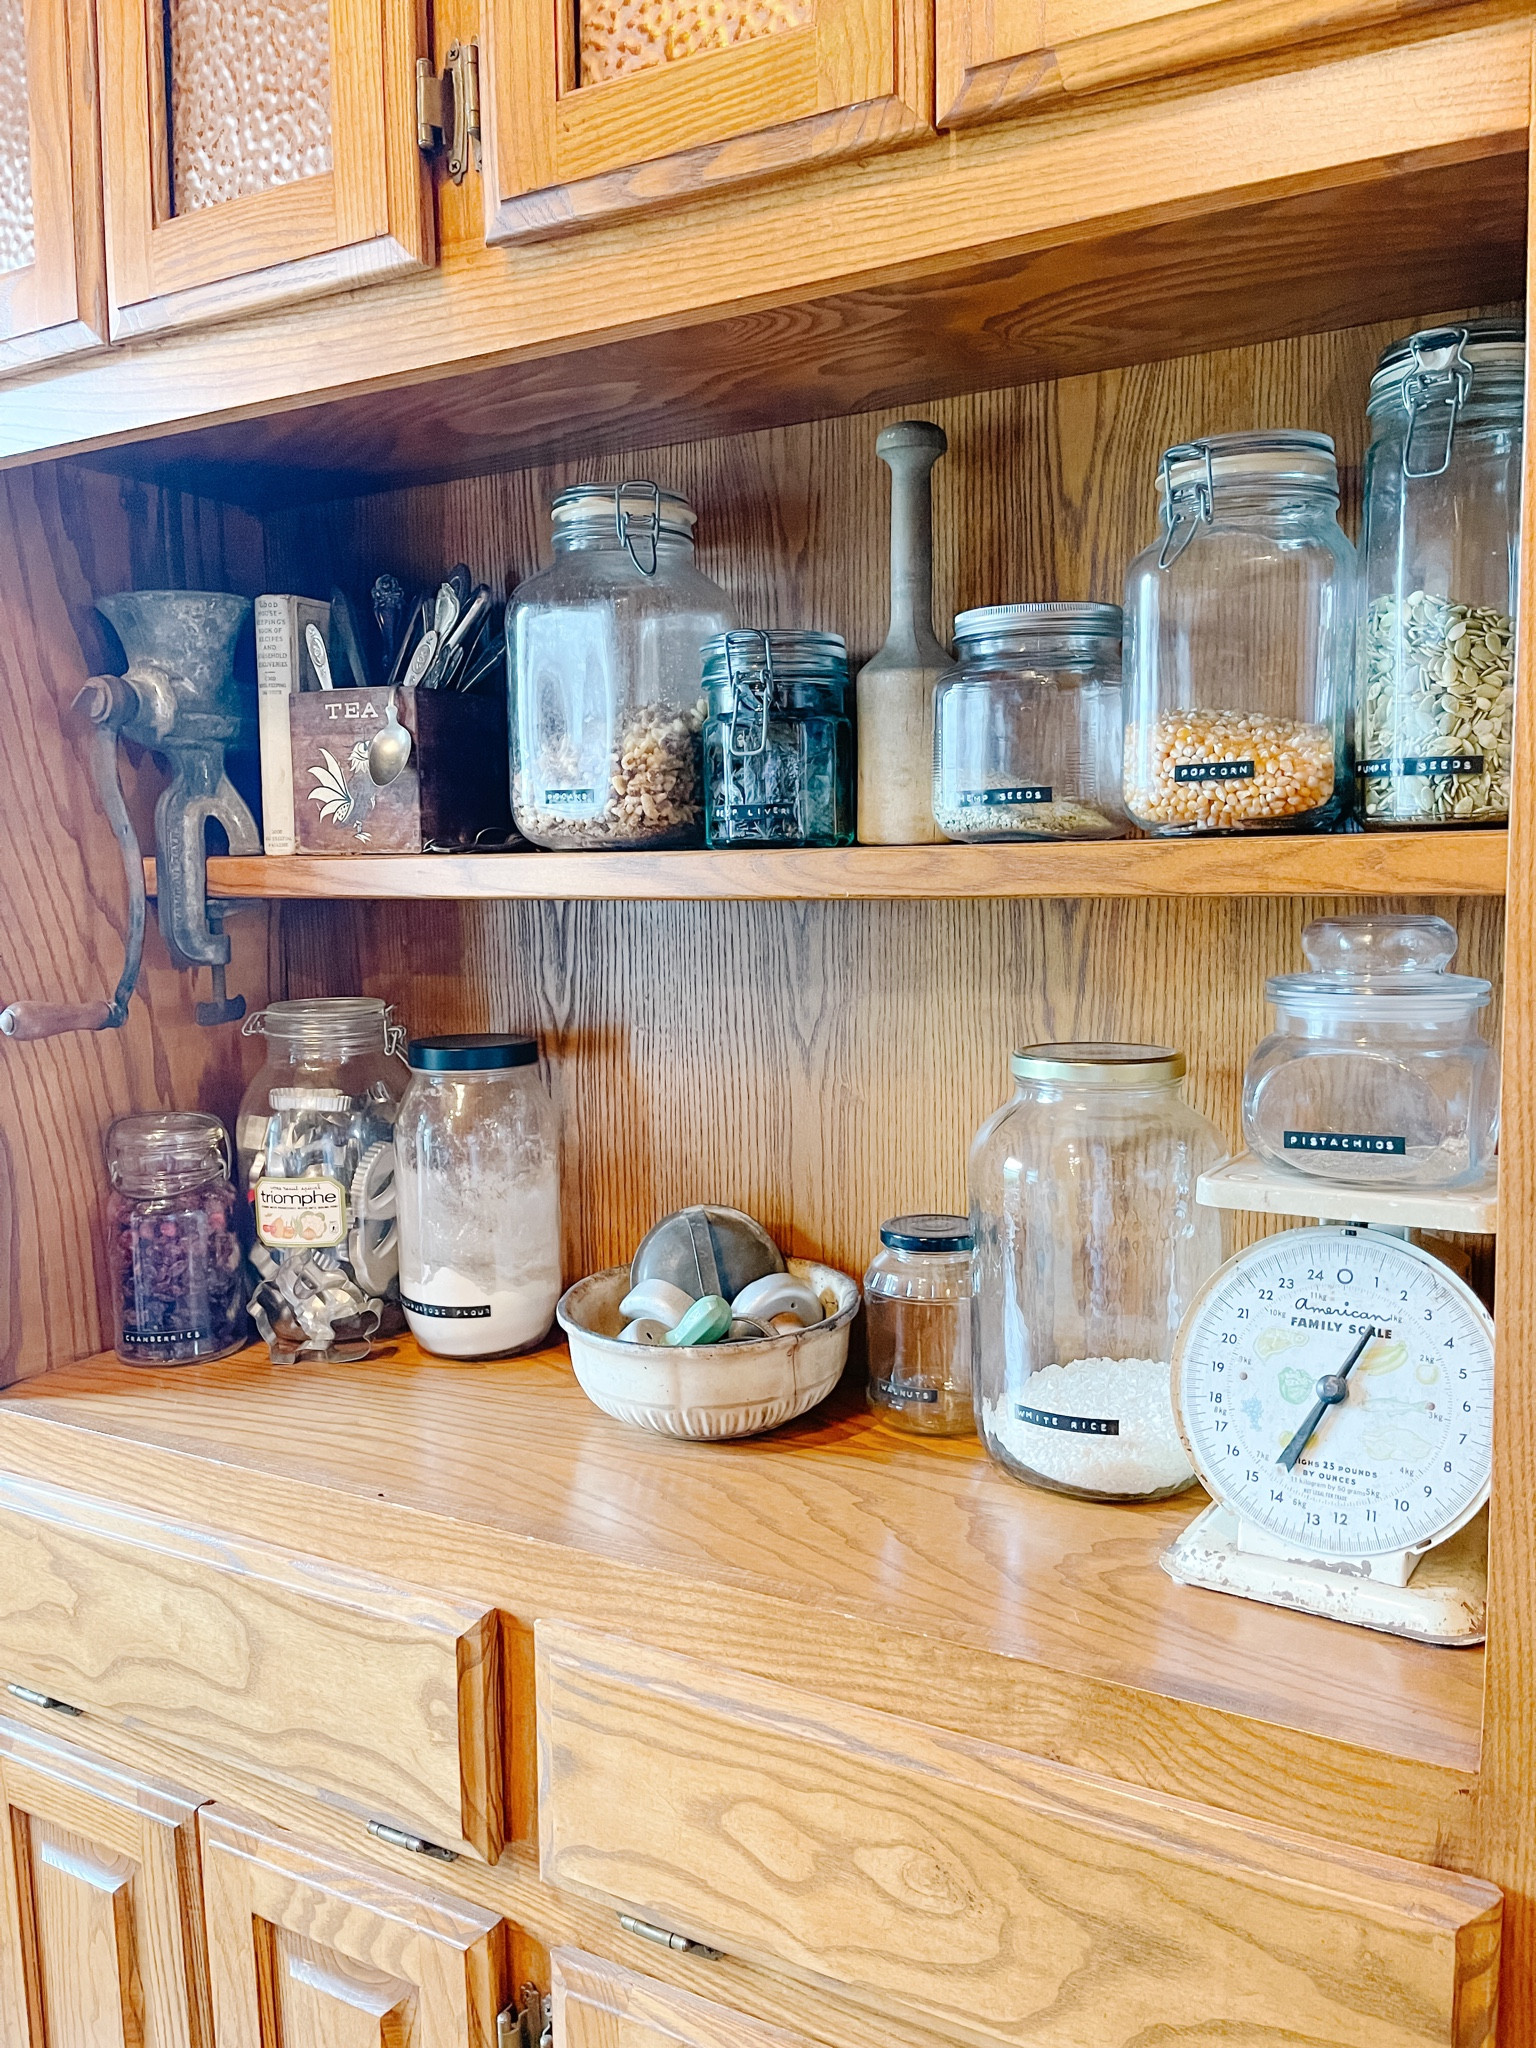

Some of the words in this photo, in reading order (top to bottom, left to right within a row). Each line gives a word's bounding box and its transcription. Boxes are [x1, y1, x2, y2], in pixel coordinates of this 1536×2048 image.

[325, 702, 378, 719] TEA
[1181, 765, 1248, 778] POPCORN
[1357, 762, 1404, 774] PUMPKN
[1417, 760, 1471, 772] SEEDS
[1000, 791, 1041, 801] SEEDS
[1290, 1136, 1395, 1151] PISTACHIOS
[261, 1190, 336, 1206] triomphe
[1307, 1269, 1324, 1281] 24
[1278, 1277, 1294, 1289] 23
[1258, 1288, 1274, 1300] 22
[1400, 1290, 1408, 1301] 2
[1237, 1307, 1249, 1319] 21
[1424, 1309, 1432, 1320] 3
[1290, 1316, 1342, 1332] FAMILY
[125, 1331, 200, 1343] CRANBERRIES
[1221, 1332, 1237, 1344] 20
[1443, 1336, 1454, 1349] 4
[1212, 1361, 1224, 1372] 19
[1459, 1368, 1467, 1379] 5
[880, 1383, 929, 1399] WALNUTS
[1209, 1391, 1222, 1403] 18
[1462, 1401, 1471, 1412] 6
[1018, 1409, 1058, 1426] WHITE
[1071, 1421, 1108, 1432] RICE
[1215, 1420, 1228, 1432] 17
[1459, 1433, 1467, 1444] 7
[1227, 1444, 1240, 1456] 16
[1323, 1461, 1335, 1470] 25
[1338, 1465, 1378, 1478] POUNDS
[1443, 1461, 1451, 1473] 8
[1246, 1470, 1259, 1482] 15
[1303, 1469, 1314, 1477] BY
[1318, 1473, 1356, 1485] OUNCES
[1270, 1489, 1284, 1503] 14
[1423, 1486, 1432, 1497] 9
[1394, 1498, 1409, 1512] 10
[1306, 1512, 1320, 1525] 13
[1334, 1512, 1347, 1525] 12
[1366, 1509, 1377, 1522] 11
